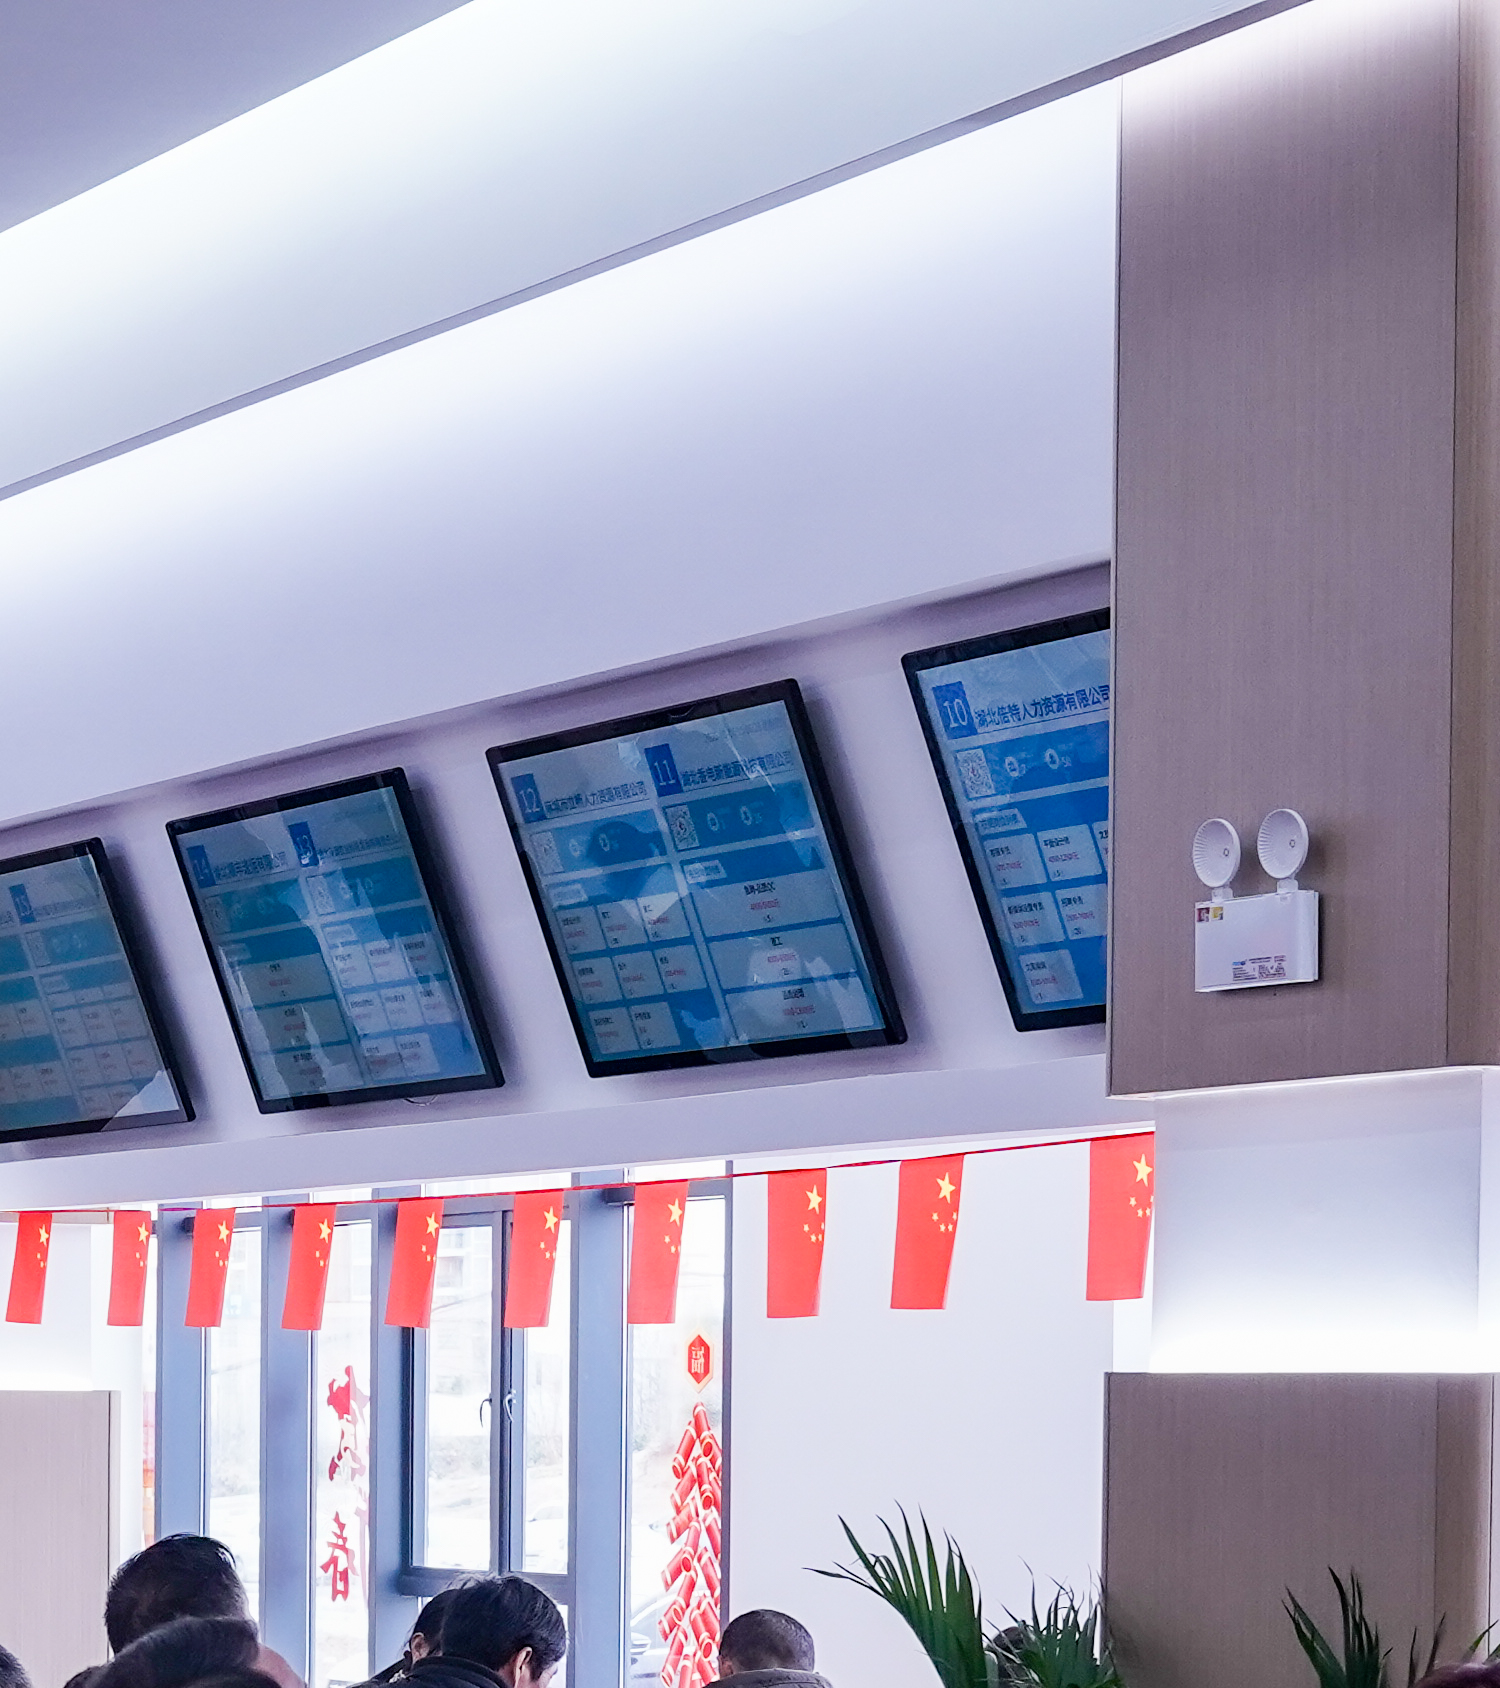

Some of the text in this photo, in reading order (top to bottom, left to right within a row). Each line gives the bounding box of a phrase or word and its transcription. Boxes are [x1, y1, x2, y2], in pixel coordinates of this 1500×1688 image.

[943, 698, 969, 728] 10
[653, 759, 677, 787] 11
[517, 785, 541, 813] 12
